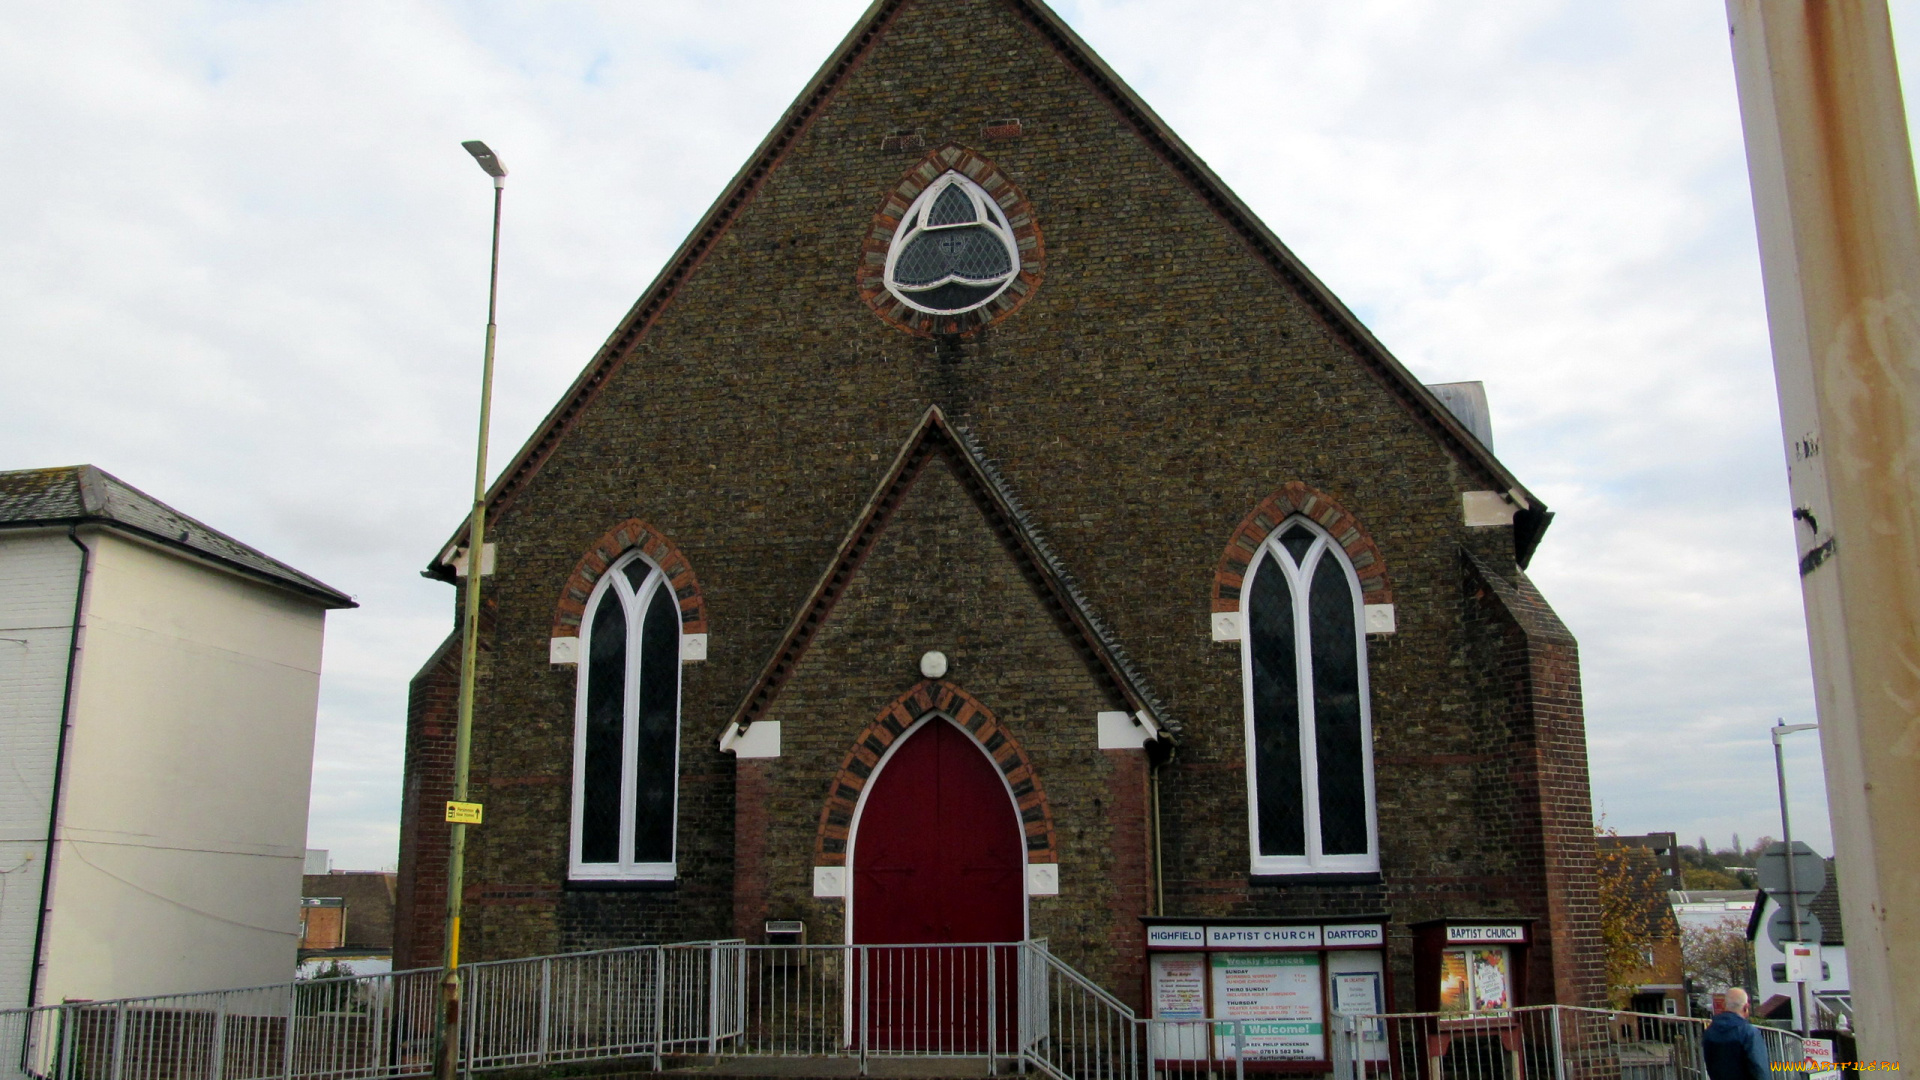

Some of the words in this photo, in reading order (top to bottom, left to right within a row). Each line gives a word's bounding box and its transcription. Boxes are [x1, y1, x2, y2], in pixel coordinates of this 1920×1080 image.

[1151, 931, 1202, 940] HIGHFIELD
[1213, 931, 1259, 940] BAPTIST
[1264, 931, 1315, 940] CHURCH
[1327, 930, 1378, 940] DARTFORD
[1451, 928, 1482, 939] BAPTIST
[1486, 928, 1517, 938] CHURCH
[1226, 957, 1260, 966] Weekly
[1263, 957, 1305, 965] Services
[1249, 1024, 1310, 1034] Welcome!
